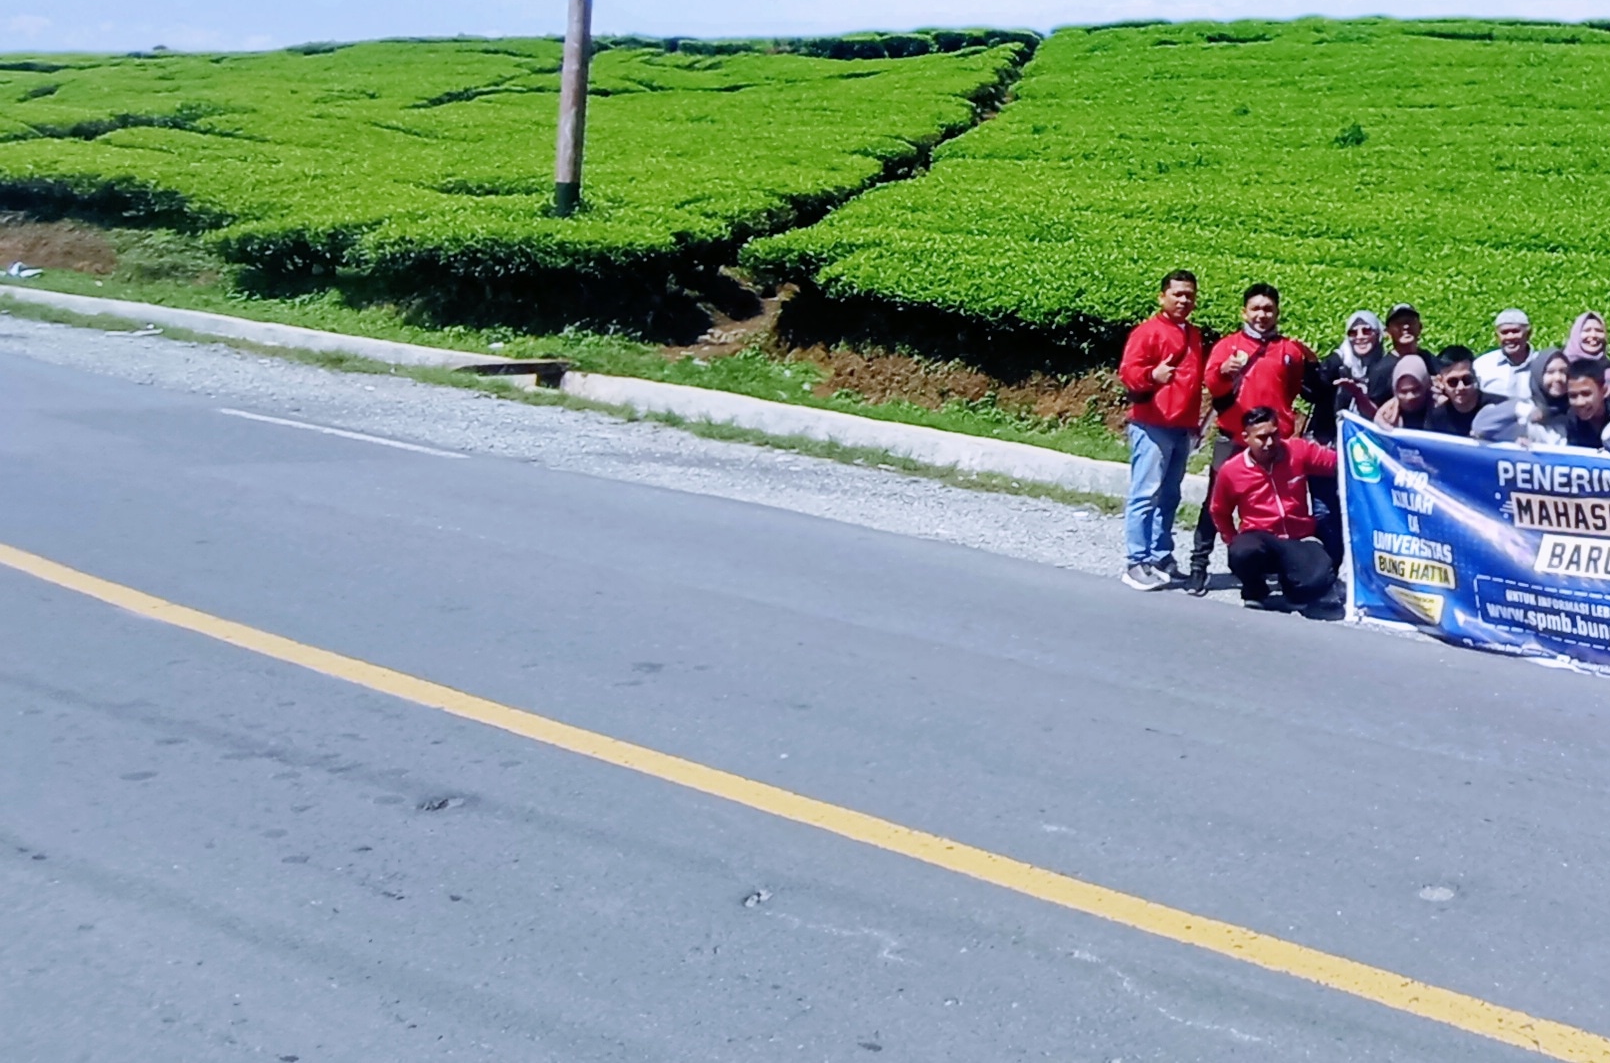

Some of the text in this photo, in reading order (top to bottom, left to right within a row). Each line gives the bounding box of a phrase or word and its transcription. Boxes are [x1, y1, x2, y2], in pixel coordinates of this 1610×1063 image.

[1373, 529, 1452, 564] UNIVERSITAS
[1378, 555, 1450, 585] BUNG HATTA
[1505, 589, 1536, 606] UNTUK
[1538, 593, 1590, 615] INFORMASI
